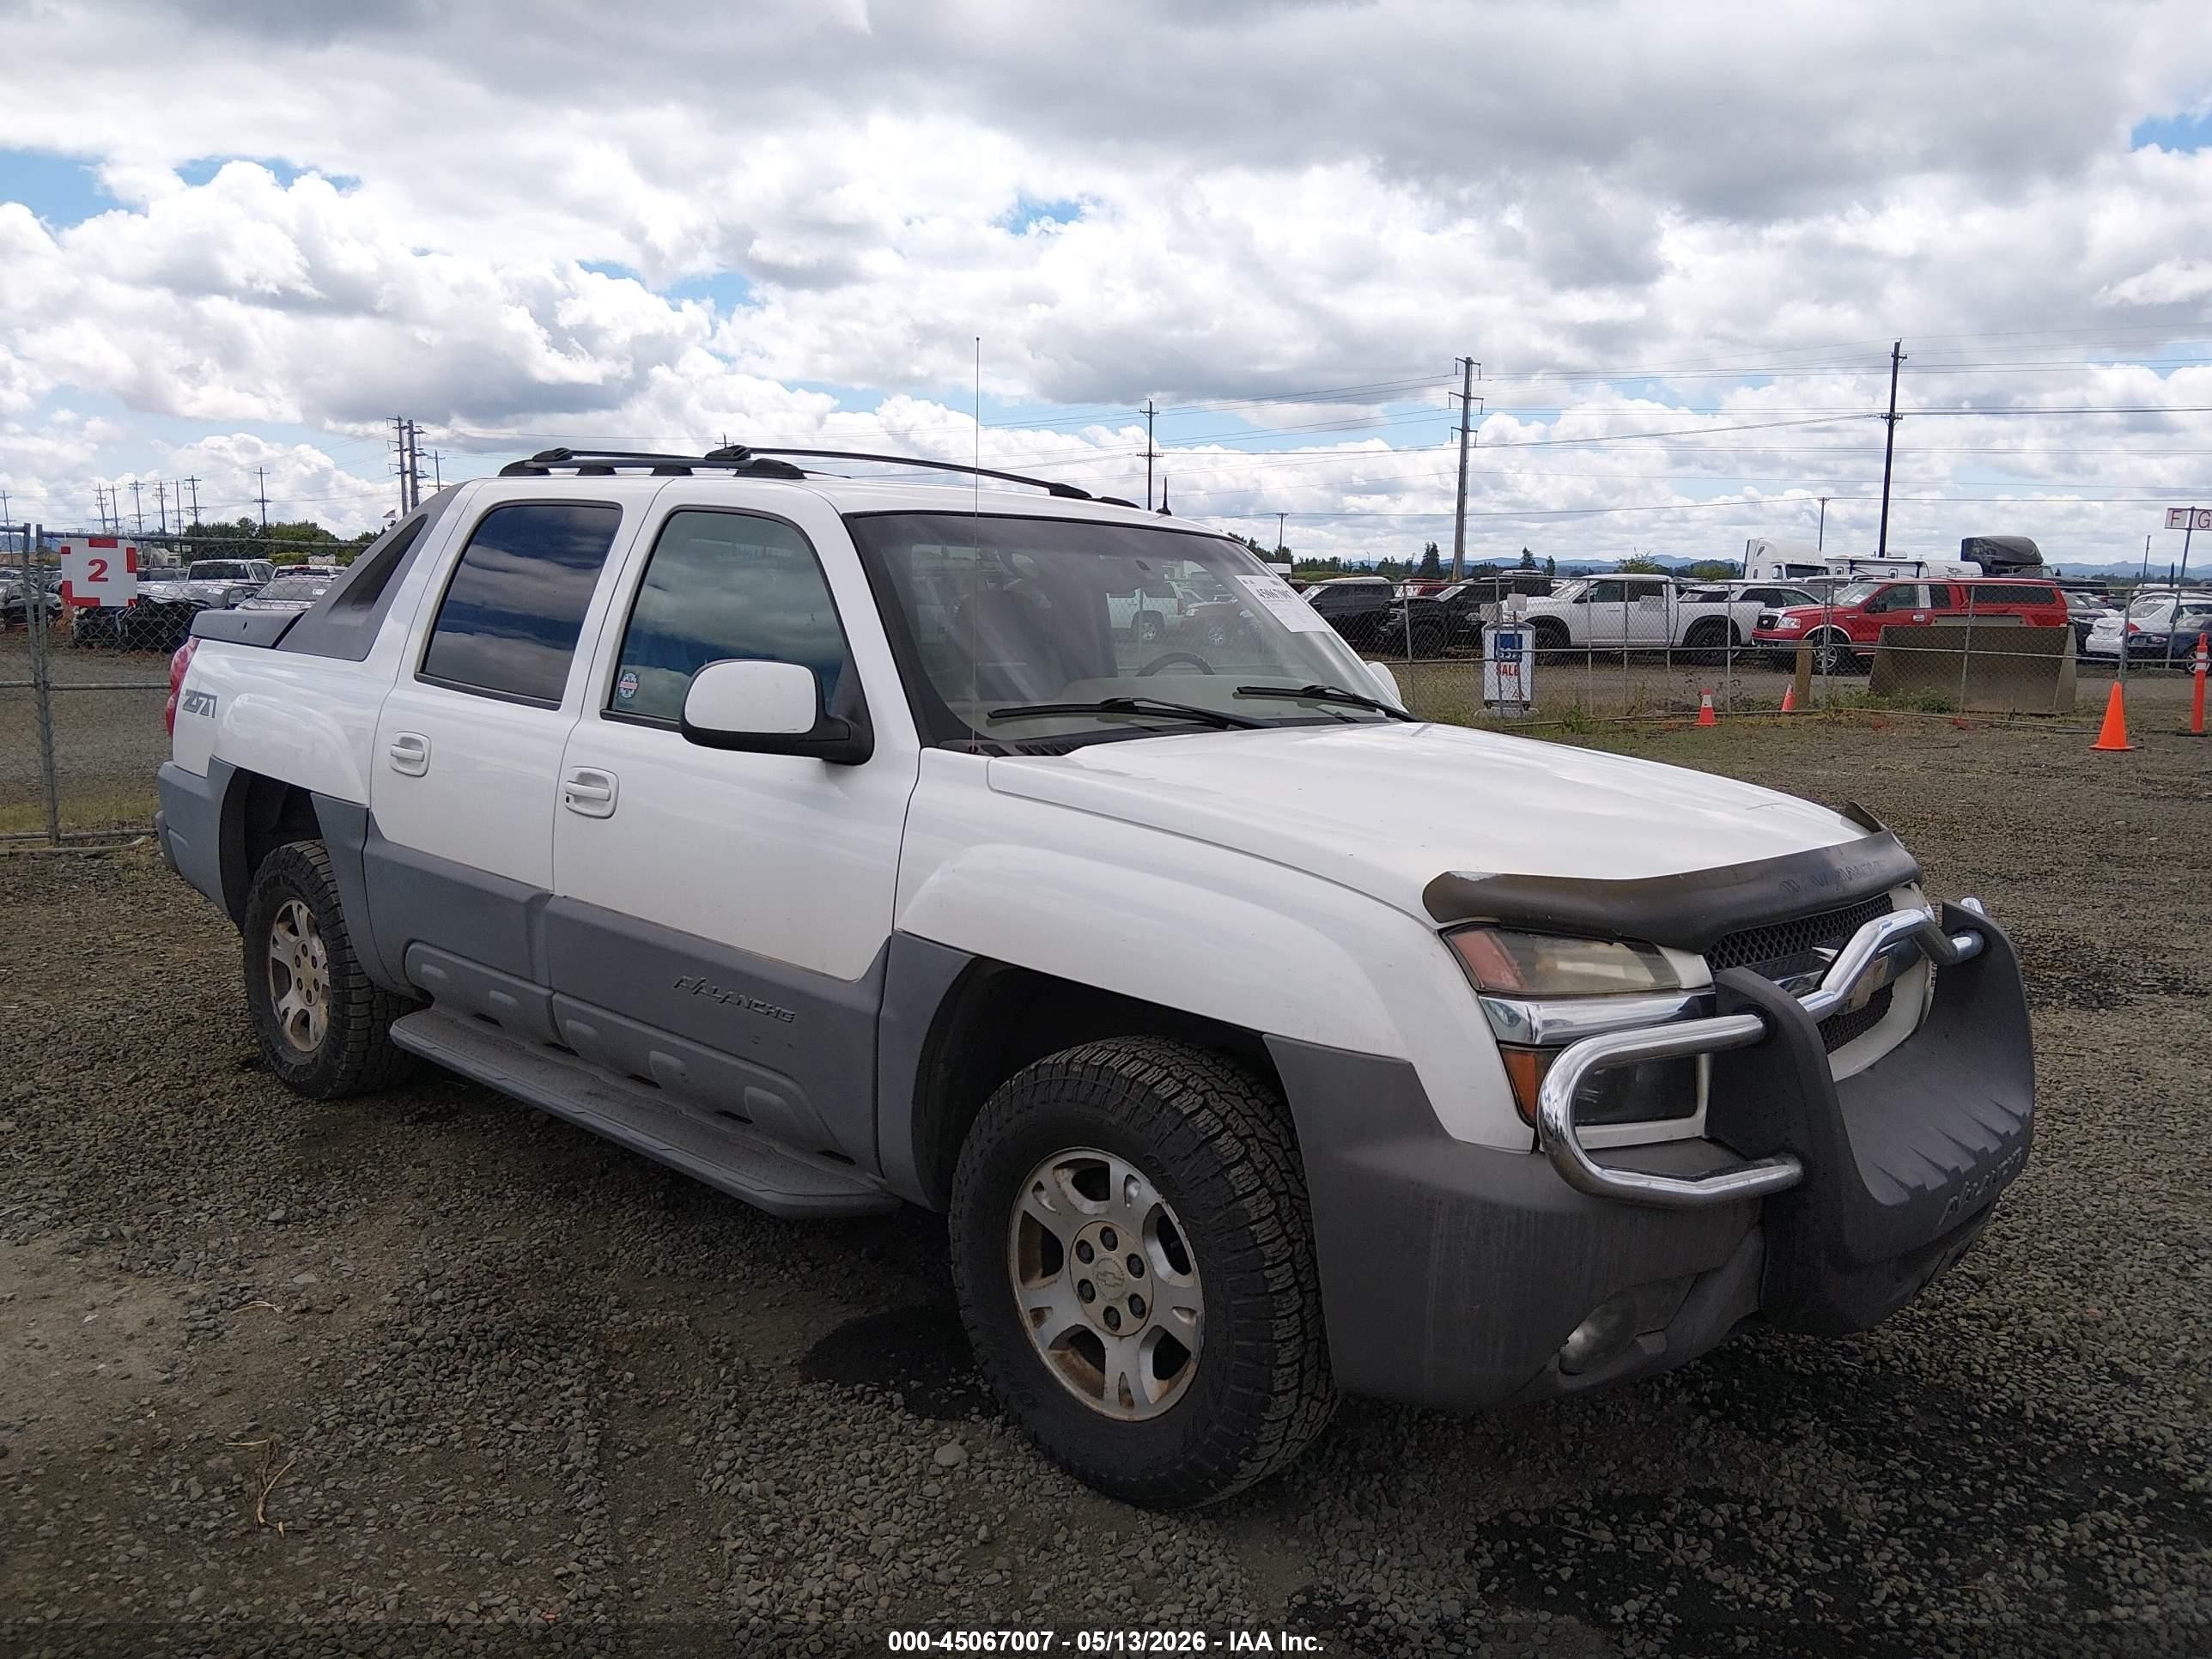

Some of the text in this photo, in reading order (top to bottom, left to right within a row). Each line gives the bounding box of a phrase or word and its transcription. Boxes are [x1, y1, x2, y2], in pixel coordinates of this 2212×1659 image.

[2171, 510, 2211, 528] F G
[88, 559, 109, 582] 2
[183, 690, 217, 719] Z71
[673, 975, 796, 1023] AVALANCHE
